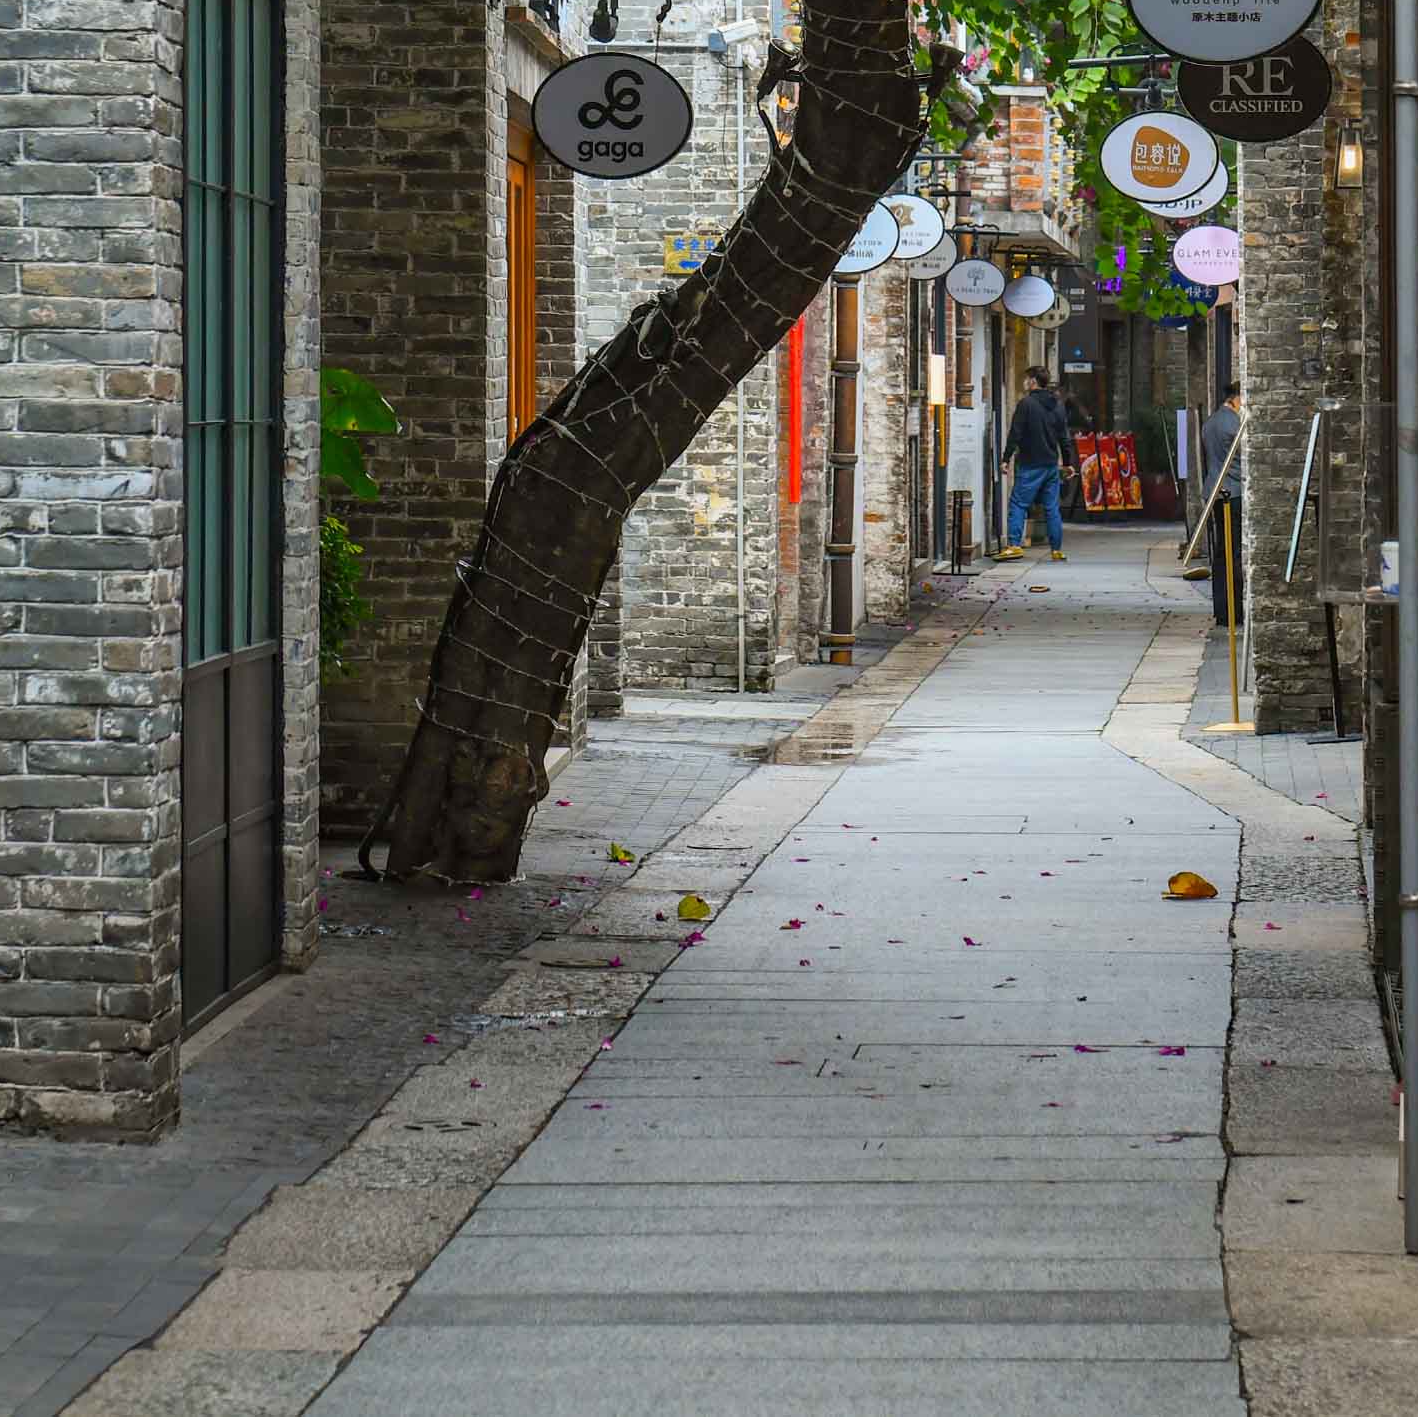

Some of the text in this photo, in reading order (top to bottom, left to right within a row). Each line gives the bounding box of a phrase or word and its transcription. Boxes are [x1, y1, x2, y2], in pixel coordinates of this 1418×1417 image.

[1220, 57, 1295, 96] RE
[1209, 100, 1304, 113] CLASSIFIED
[578, 141, 644, 163] gaga
[1177, 248, 1239, 258] GLAM EVE
